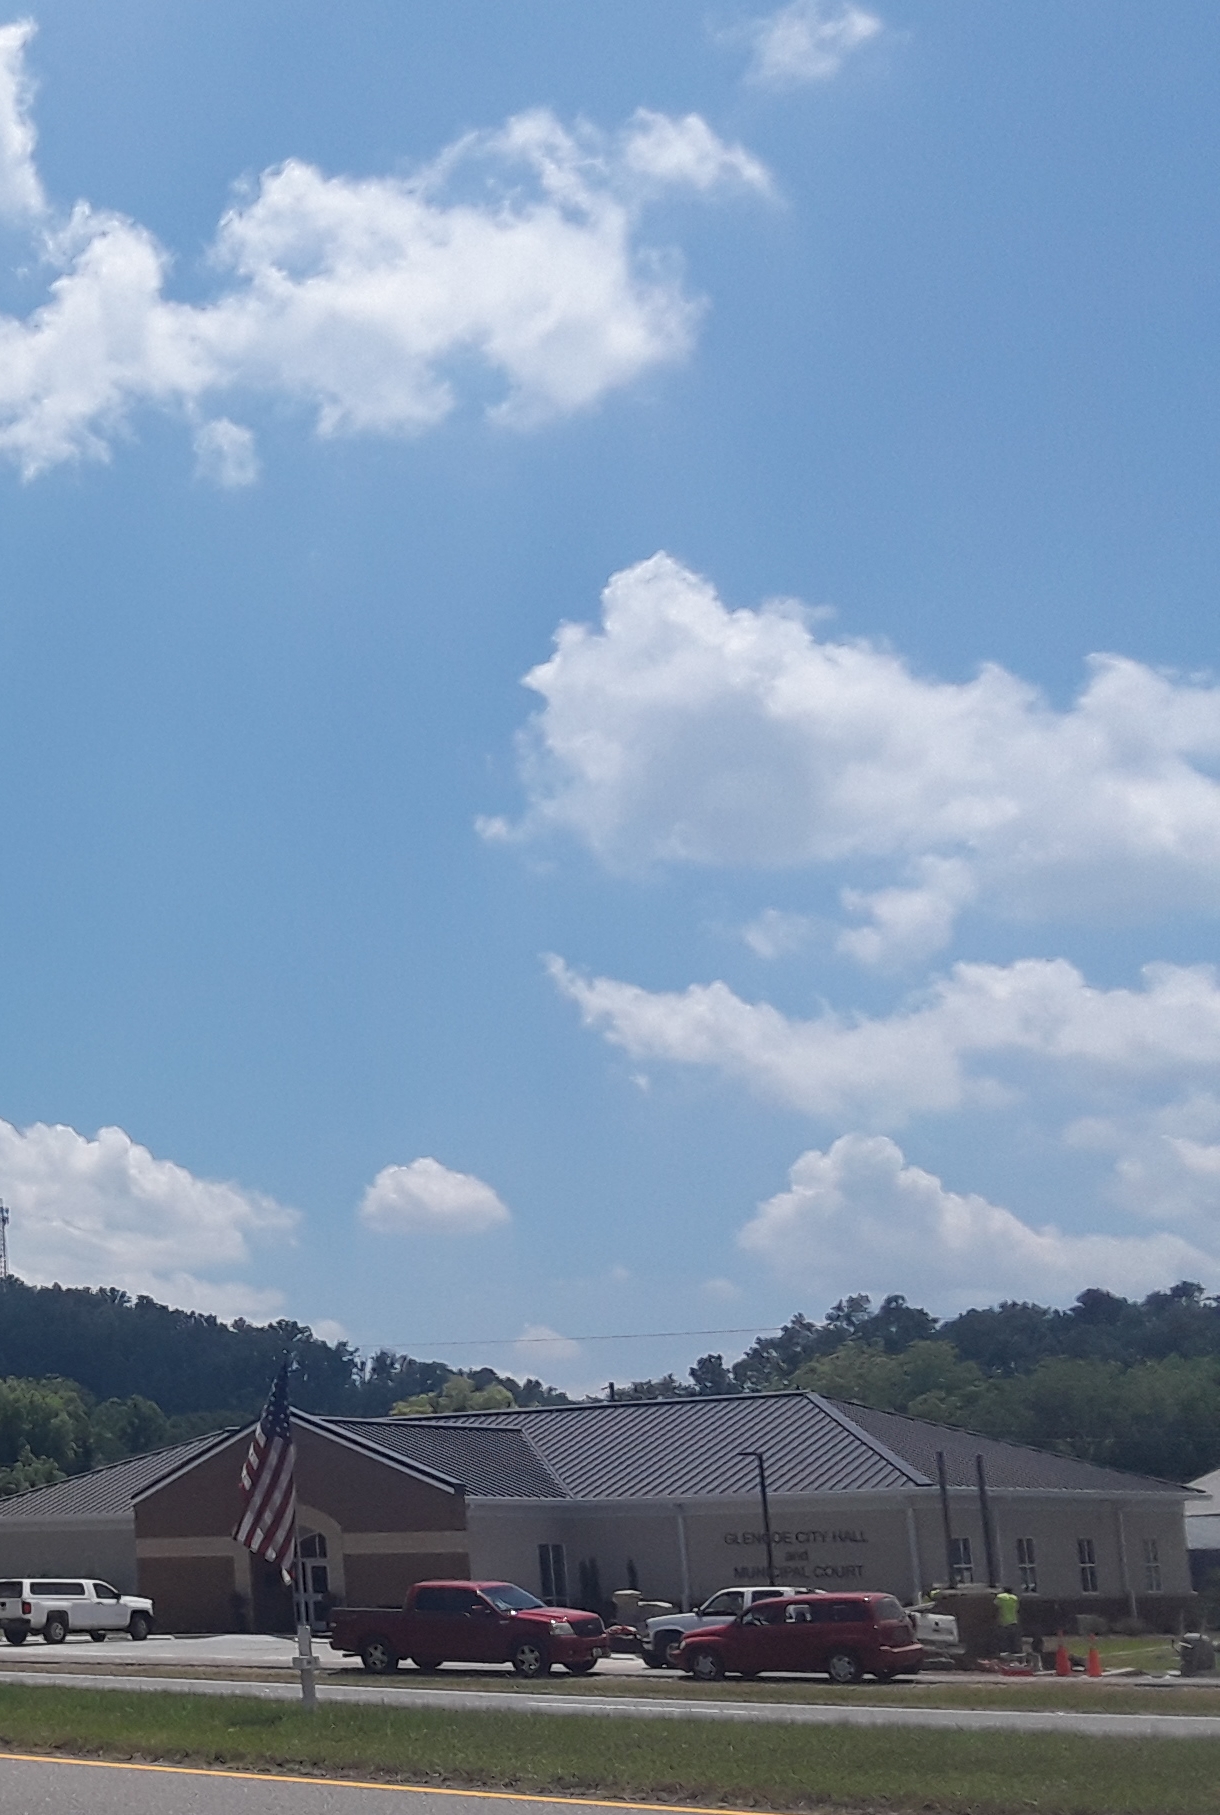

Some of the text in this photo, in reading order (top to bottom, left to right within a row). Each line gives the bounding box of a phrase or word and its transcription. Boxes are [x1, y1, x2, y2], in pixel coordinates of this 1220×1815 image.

[795, 1531, 827, 1544] CITY
[832, 1530, 869, 1543] HALL
[785, 1550, 809, 1561] and
[813, 1565, 863, 1578] COURT
